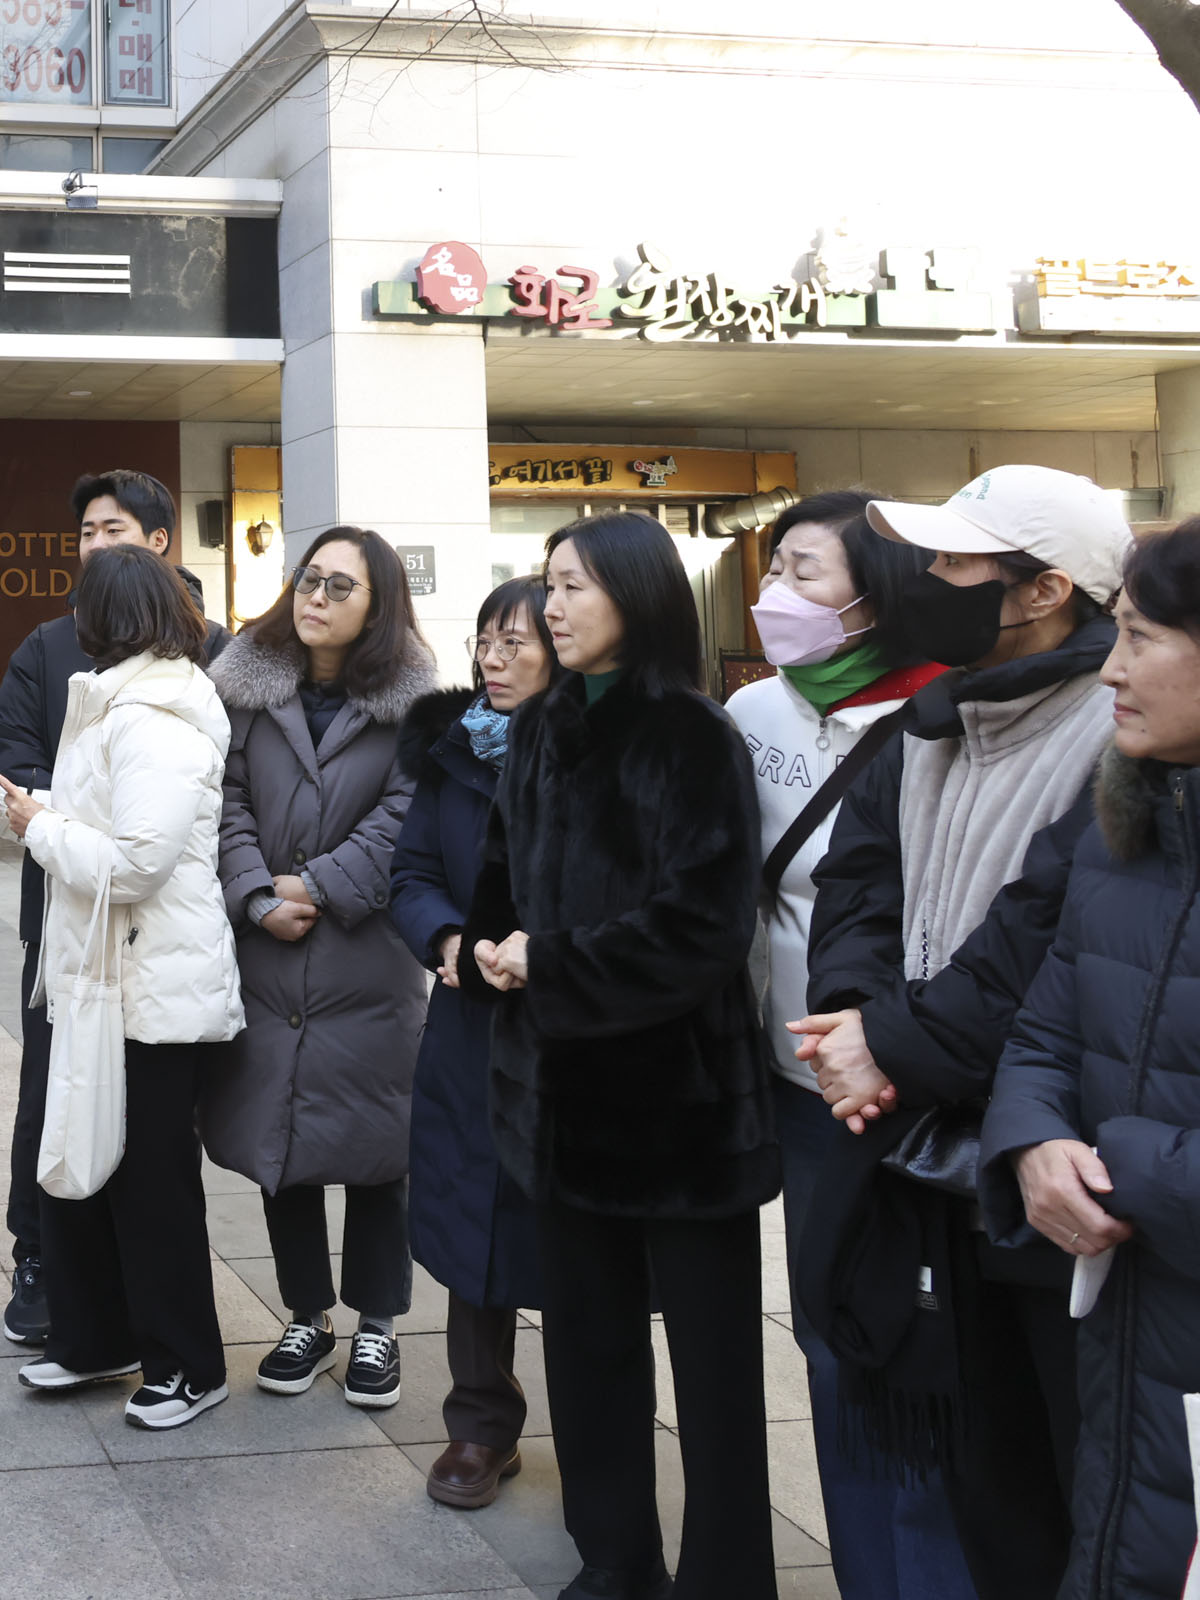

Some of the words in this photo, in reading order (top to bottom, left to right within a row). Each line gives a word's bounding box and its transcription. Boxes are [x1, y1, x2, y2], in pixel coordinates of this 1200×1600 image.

[2, 45, 86, 94] 3060
[508, 265, 613, 331] 화로
[507, 458, 579, 482] 여기서
[584, 456, 613, 485] 끝!
[406, 553, 426, 570] 51
